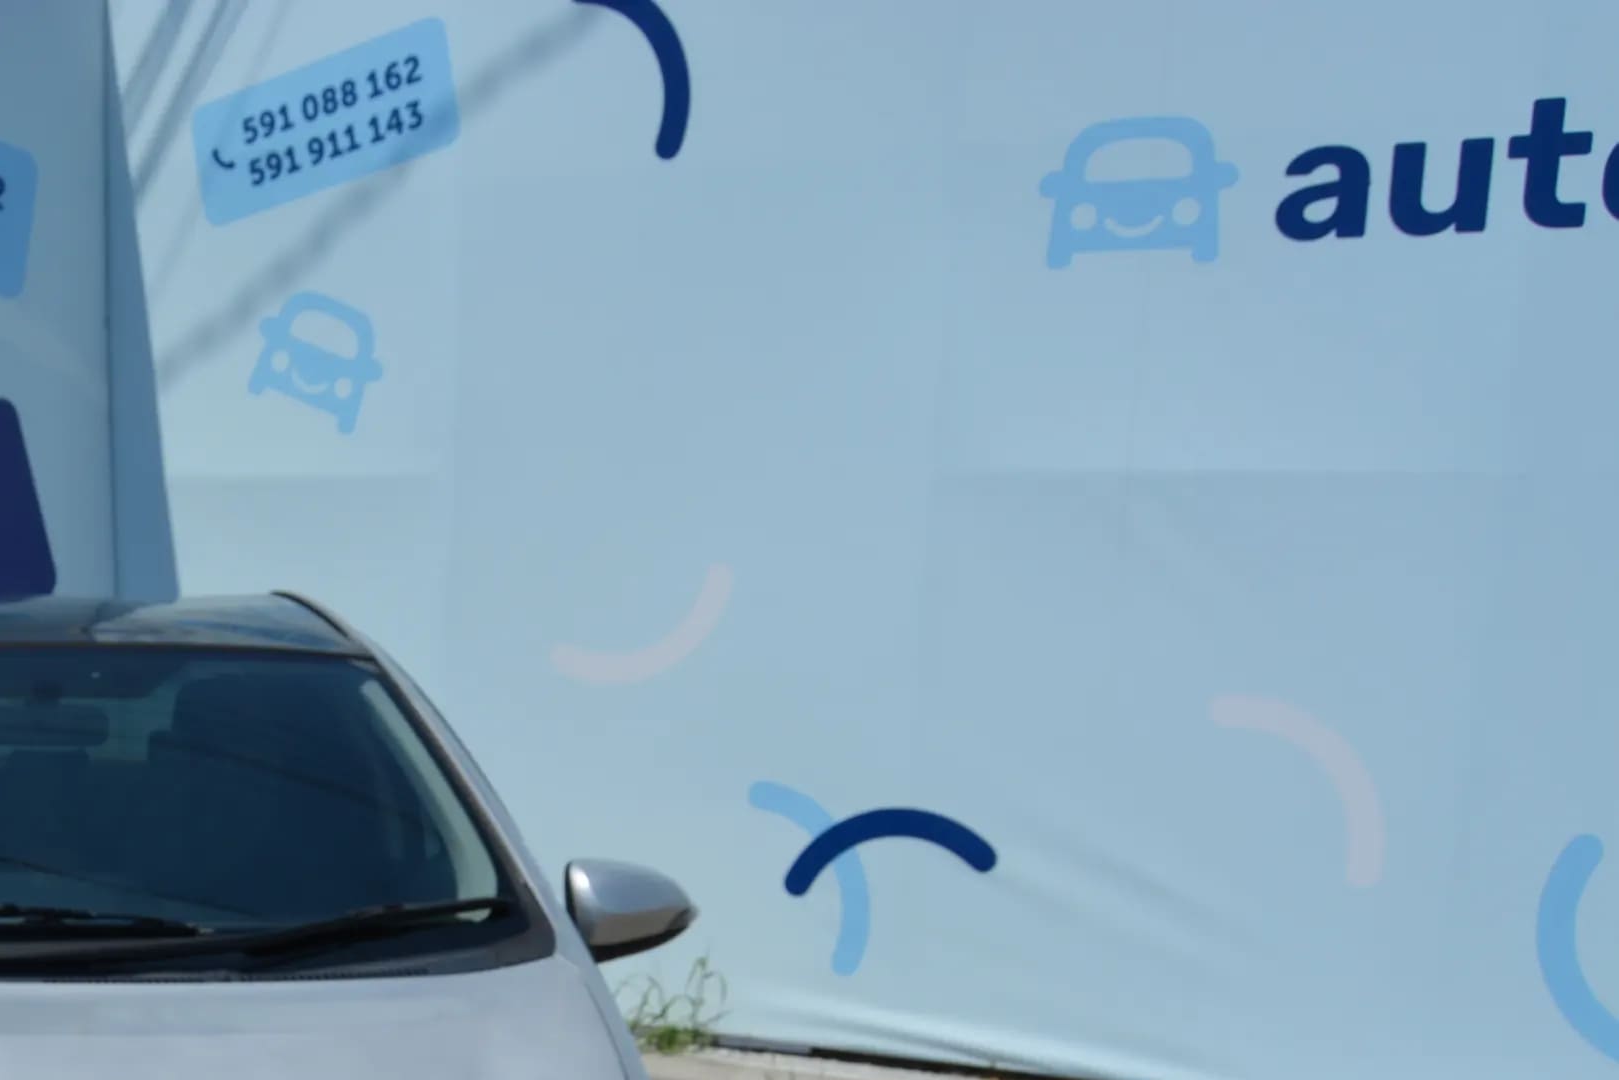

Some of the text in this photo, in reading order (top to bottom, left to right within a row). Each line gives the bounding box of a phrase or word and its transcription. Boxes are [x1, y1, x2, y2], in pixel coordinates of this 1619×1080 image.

[243, 55, 422, 144] 591 088 162
[249, 100, 423, 187] 591 911 143
[1275, 97, 1619, 241] aut
